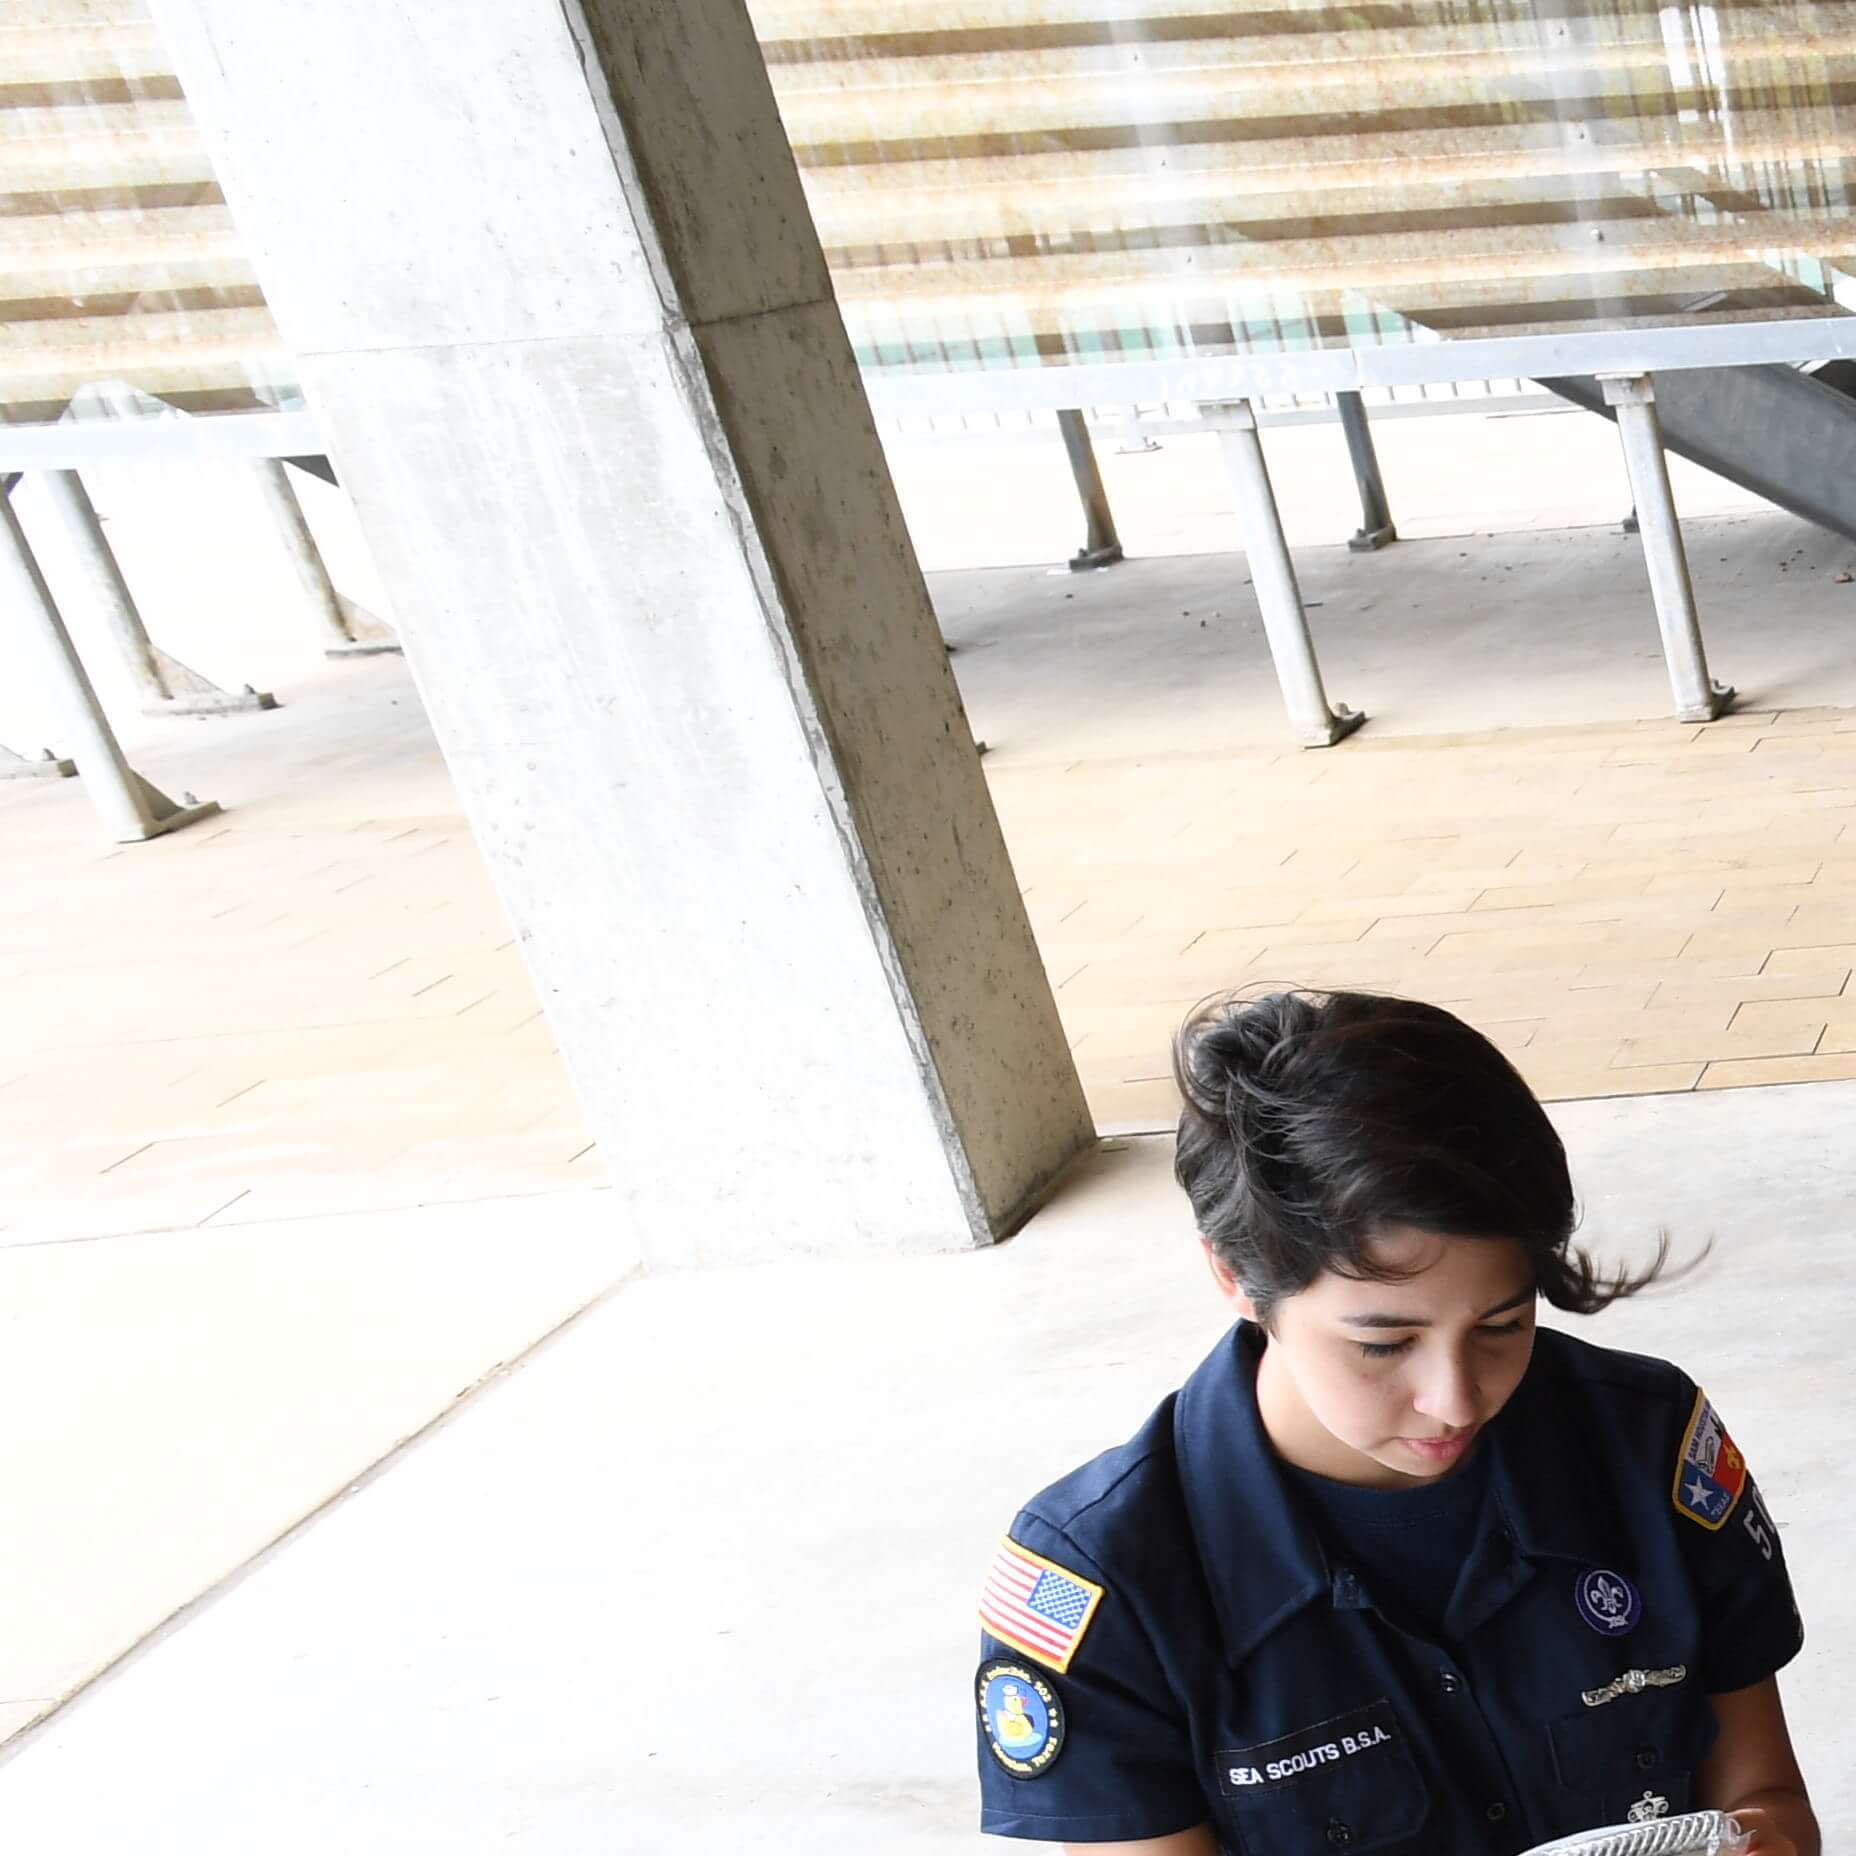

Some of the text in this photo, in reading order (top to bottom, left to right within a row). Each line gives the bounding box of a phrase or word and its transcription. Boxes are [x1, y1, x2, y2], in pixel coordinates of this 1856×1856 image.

[1228, 1726, 1391, 1786] SEA SCOUTS B.S.A.
